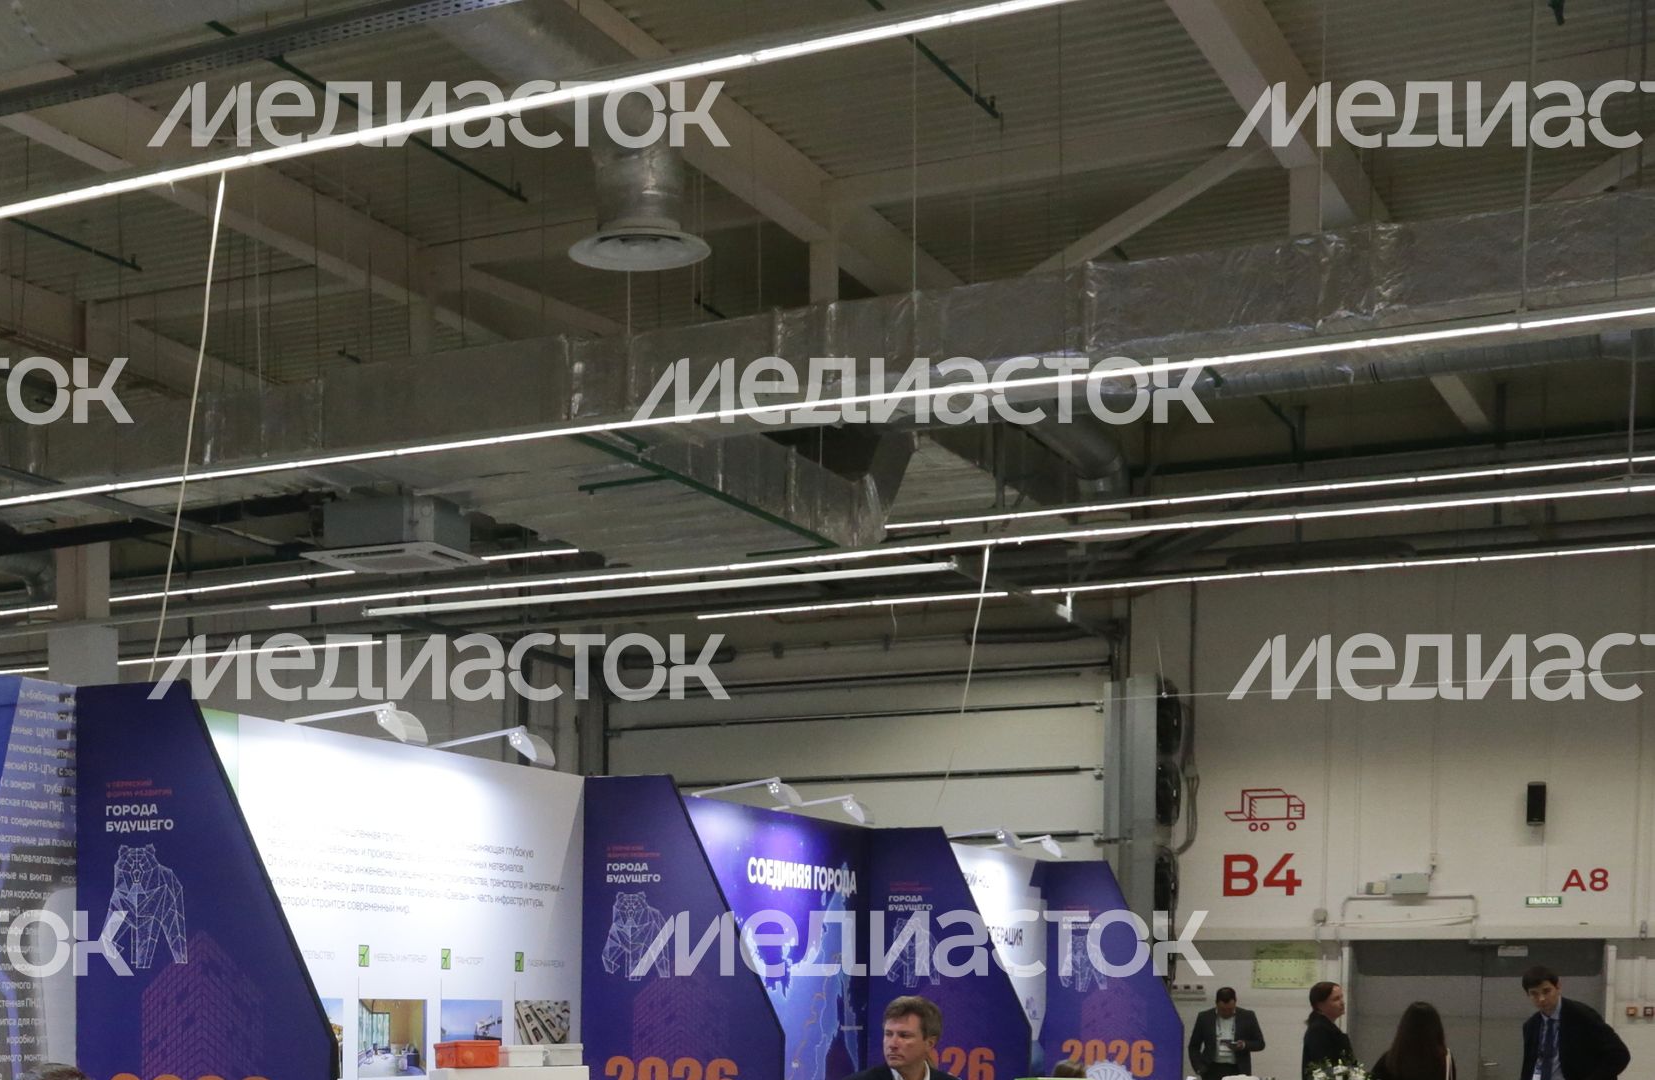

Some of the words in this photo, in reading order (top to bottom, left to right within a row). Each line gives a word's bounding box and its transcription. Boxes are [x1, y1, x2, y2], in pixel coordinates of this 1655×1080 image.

[106, 803, 158, 816] ГОРОДА
[106, 818, 174, 833] БУДУЩЕГО
[606, 862, 649, 873] ГОРОДА
[606, 873, 661, 883] БУДУЩЕГО
[747, 856, 812, 891] СОЕДИНЯЯ
[813, 865, 857, 898] ГОРОДА
[888, 894, 923, 902] ГОРОДА
[1528, 896, 1559, 905] ВЫХОД
[888, 903, 933, 912] БУДУЩЕГО
[1061, 1038, 1155, 1078] 2026
